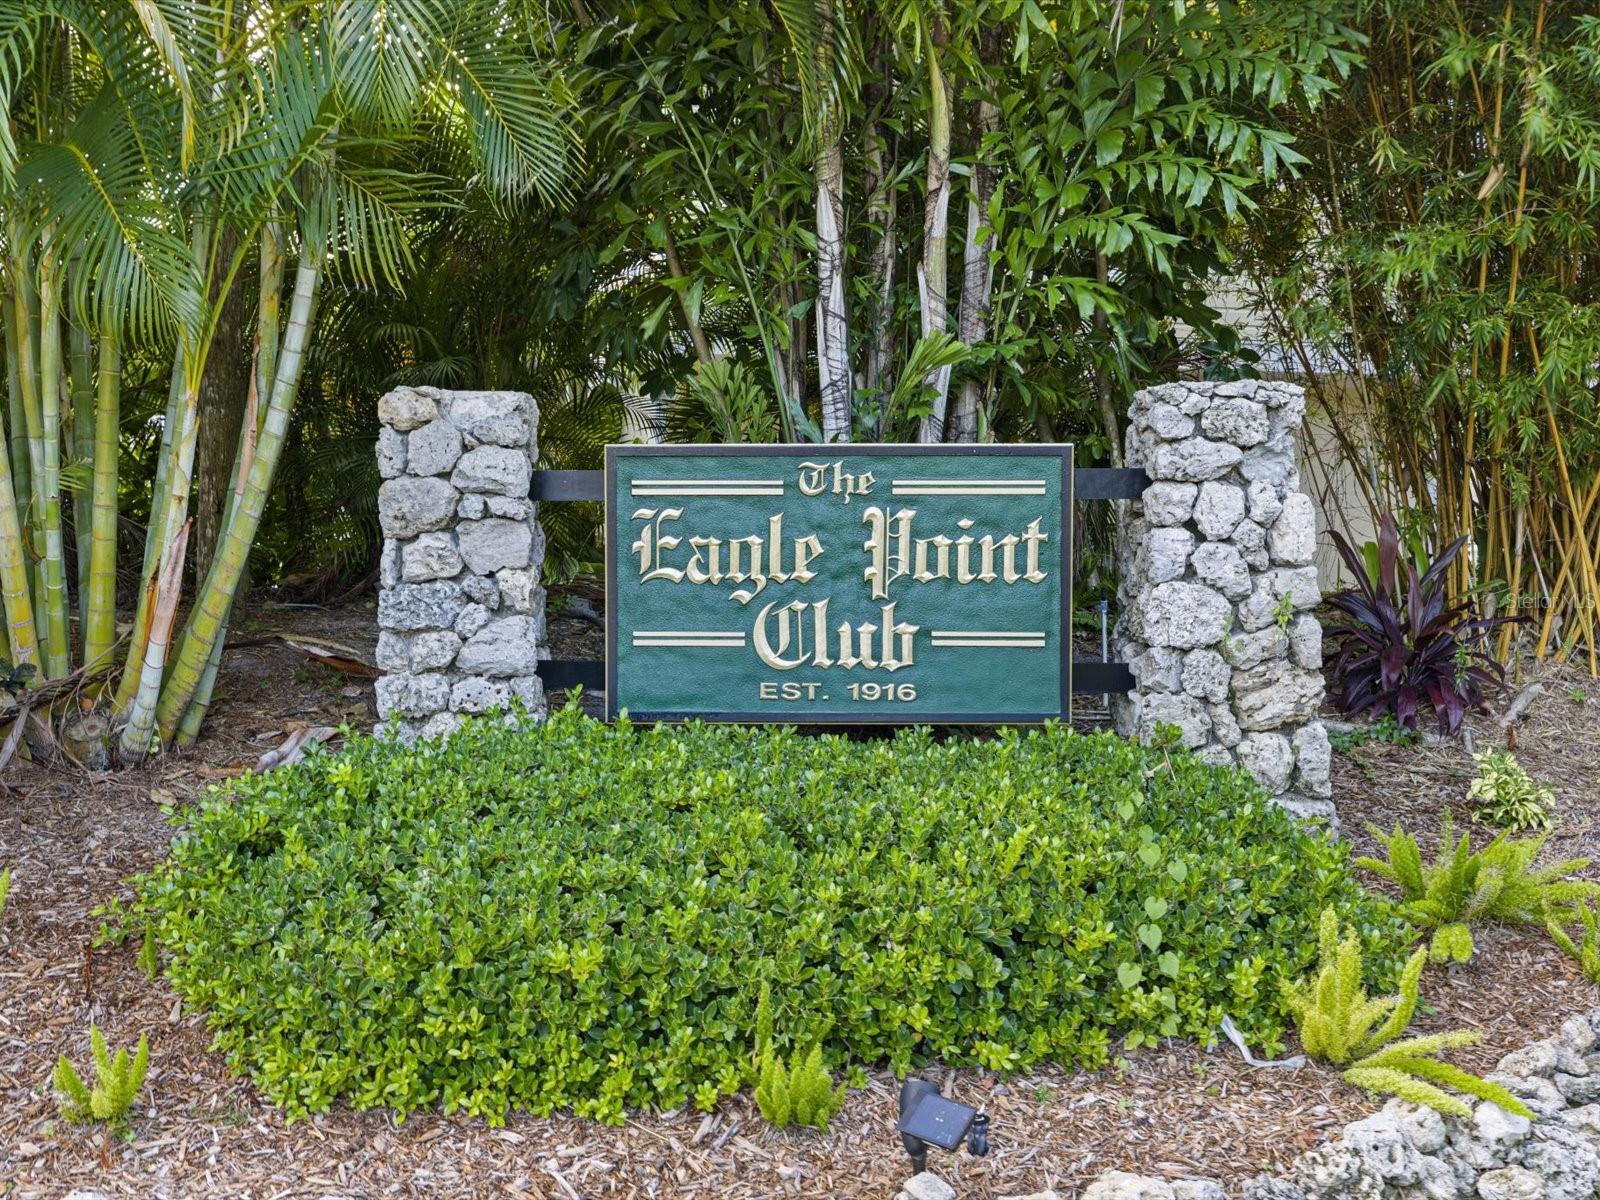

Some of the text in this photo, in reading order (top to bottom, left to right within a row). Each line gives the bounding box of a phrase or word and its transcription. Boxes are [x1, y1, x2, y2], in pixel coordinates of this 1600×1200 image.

[798, 460, 877, 504] The
[631, 506, 1049, 605] Eagle Point
[752, 598, 921, 672] Club
[758, 682, 918, 702] EST. 1916
